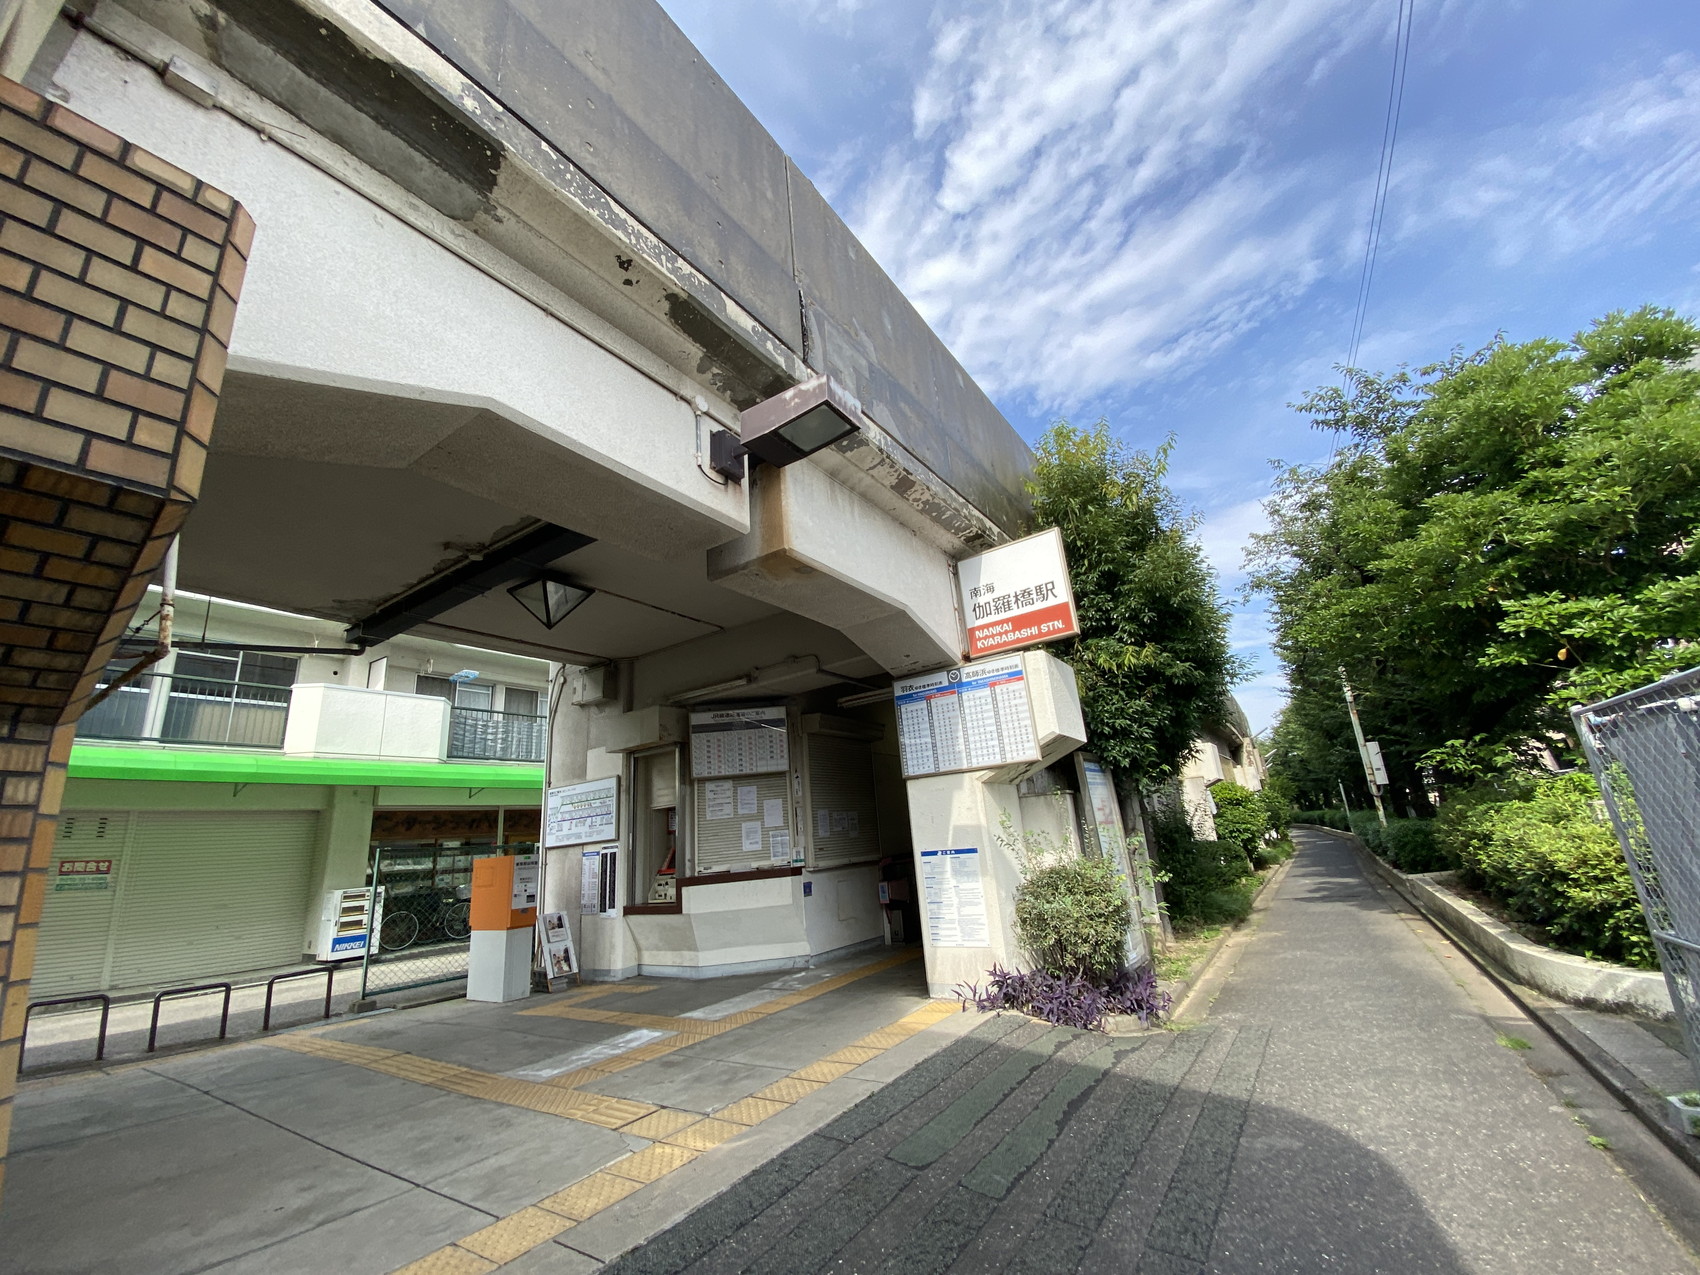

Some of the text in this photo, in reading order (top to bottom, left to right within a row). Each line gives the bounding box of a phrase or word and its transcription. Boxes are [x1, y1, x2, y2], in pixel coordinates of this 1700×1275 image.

[969, 582, 995, 600] 南海
[972, 580, 1058, 621] 伽羅橋駅
[975, 621, 1013, 639] NANKAI
[976, 619, 1066, 649] KYARABASHI STN.
[61, 861, 110, 872] お問合せ
[333, 940, 365, 952] NIKKEI
